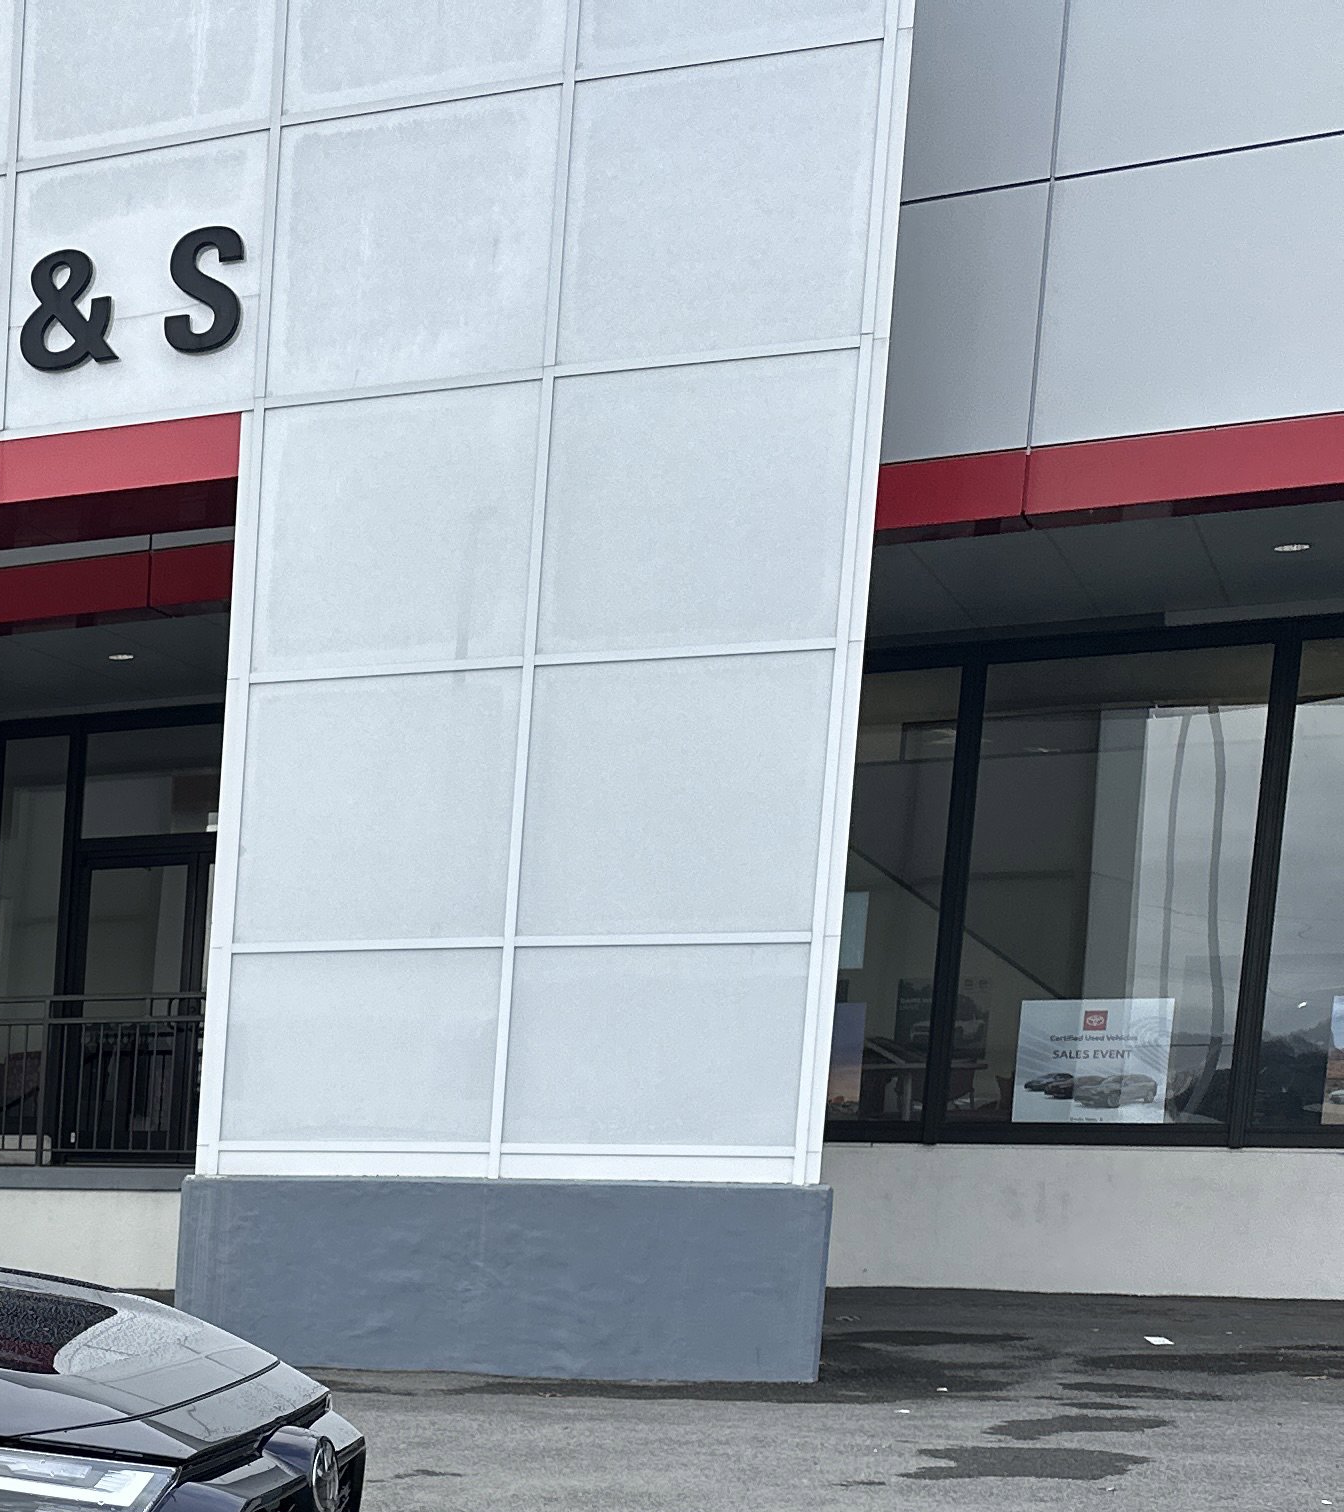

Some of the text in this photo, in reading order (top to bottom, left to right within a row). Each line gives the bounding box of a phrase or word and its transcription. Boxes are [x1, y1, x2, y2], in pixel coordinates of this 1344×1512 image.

[20, 248, 119, 372] &
[164, 225, 245, 353] S
[1052, 1049, 1132, 1060] SALES EVENT
